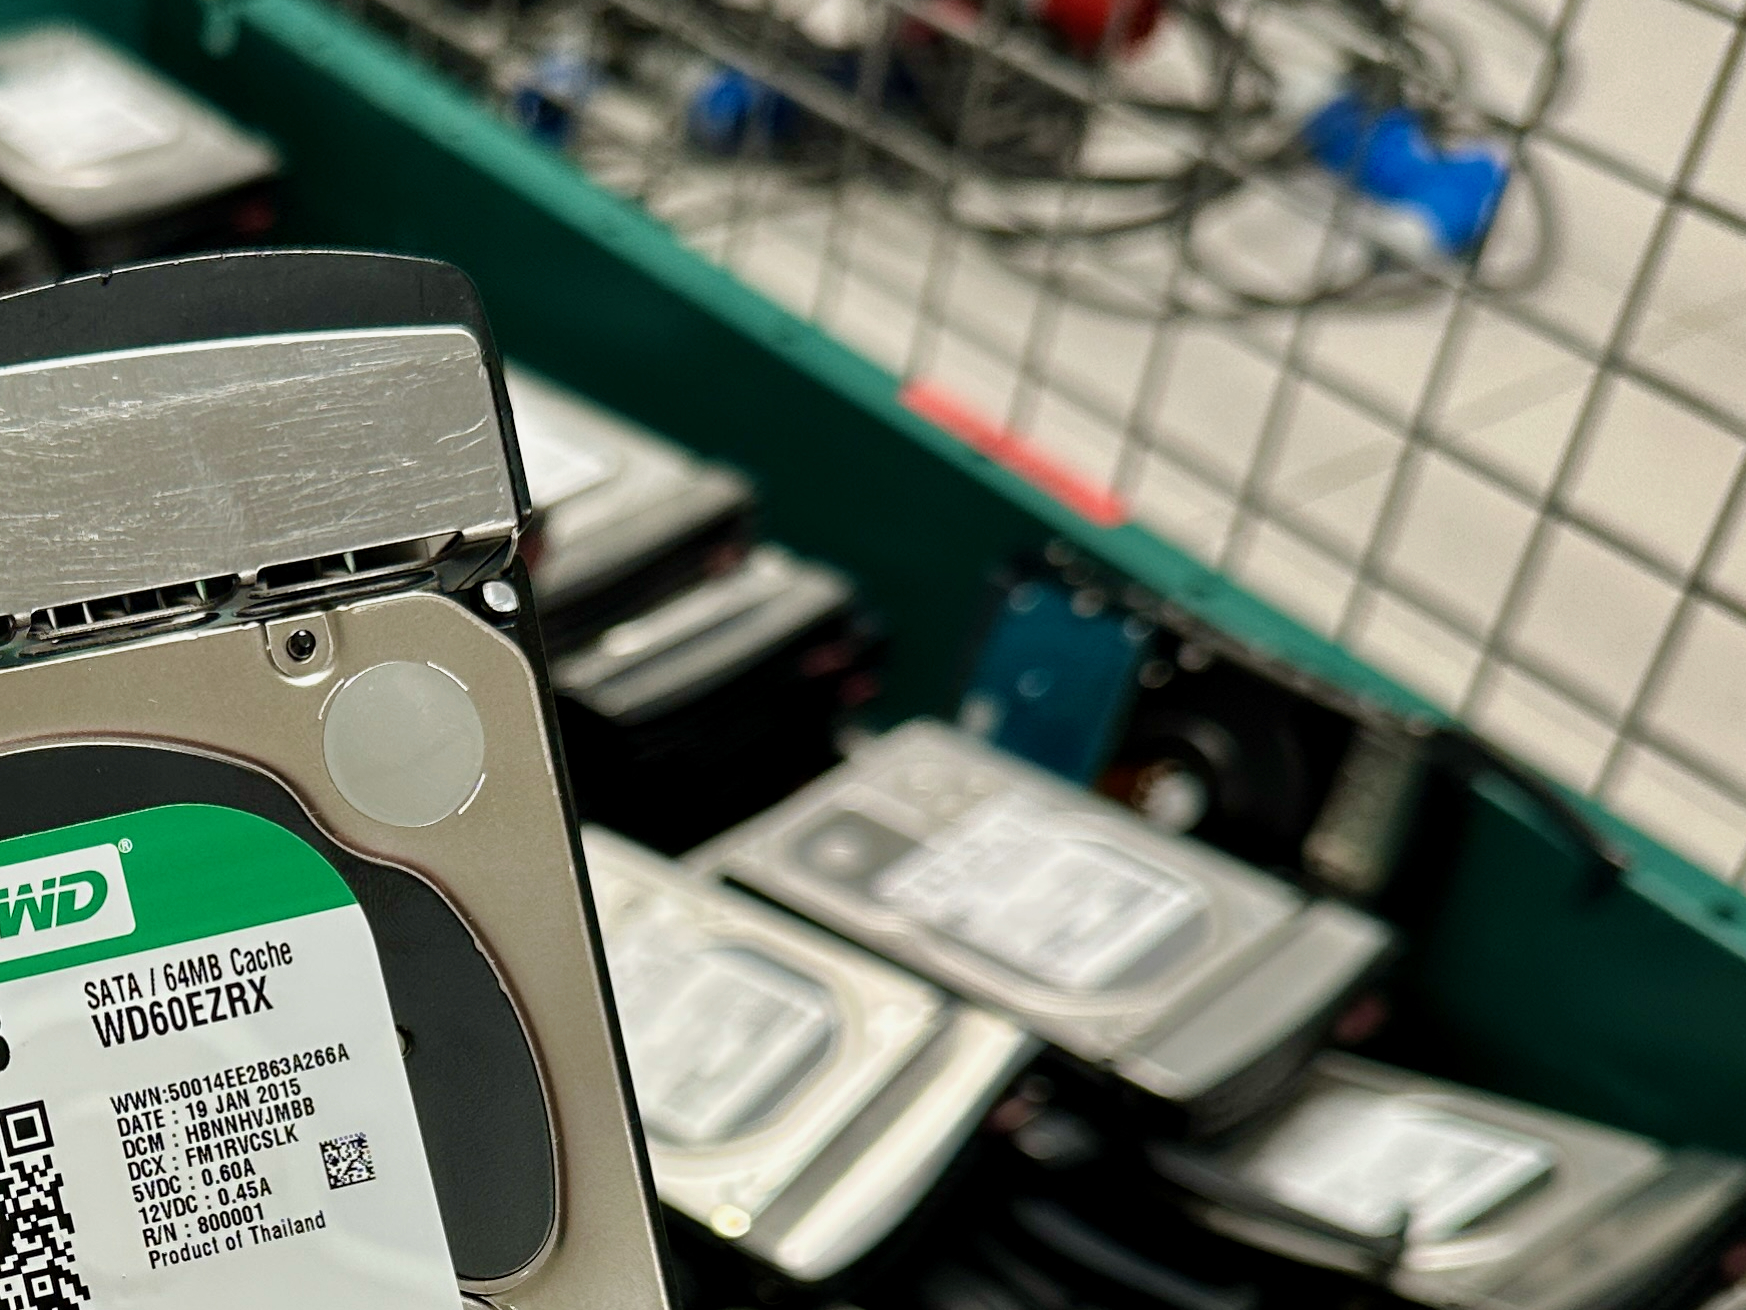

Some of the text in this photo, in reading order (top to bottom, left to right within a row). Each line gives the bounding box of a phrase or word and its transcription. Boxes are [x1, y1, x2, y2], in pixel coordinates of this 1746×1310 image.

[83, 972, 144, 1011] SATA
[163, 953, 223, 992] 64MB
[229, 940, 293, 977] Cache
[90, 975, 274, 1049] WD60EZRX
[116, 1108, 166, 1138] DATE
[184, 1099, 208, 1121] 19
[215, 1088, 251, 1115] JAN
[256, 1077, 302, 1105] 2015
[121, 1131, 166, 1160] DCM
[184, 1096, 316, 1145] HBNNHVJMBB
[126, 1153, 168, 1182] DCX
[184, 1123, 300, 1168] FM1RVCSLK
[131, 1174, 182, 1204] 5VDC
[200, 1157, 257, 1187] 0.60A
[137, 1194, 199, 1225] 12VDC
[217, 1176, 273, 1206] 0.45A
[142, 1222, 178, 1248] R/N
[197, 1202, 265, 1235] 800001
[148, 1209, 327, 1270] Product of Thailand
